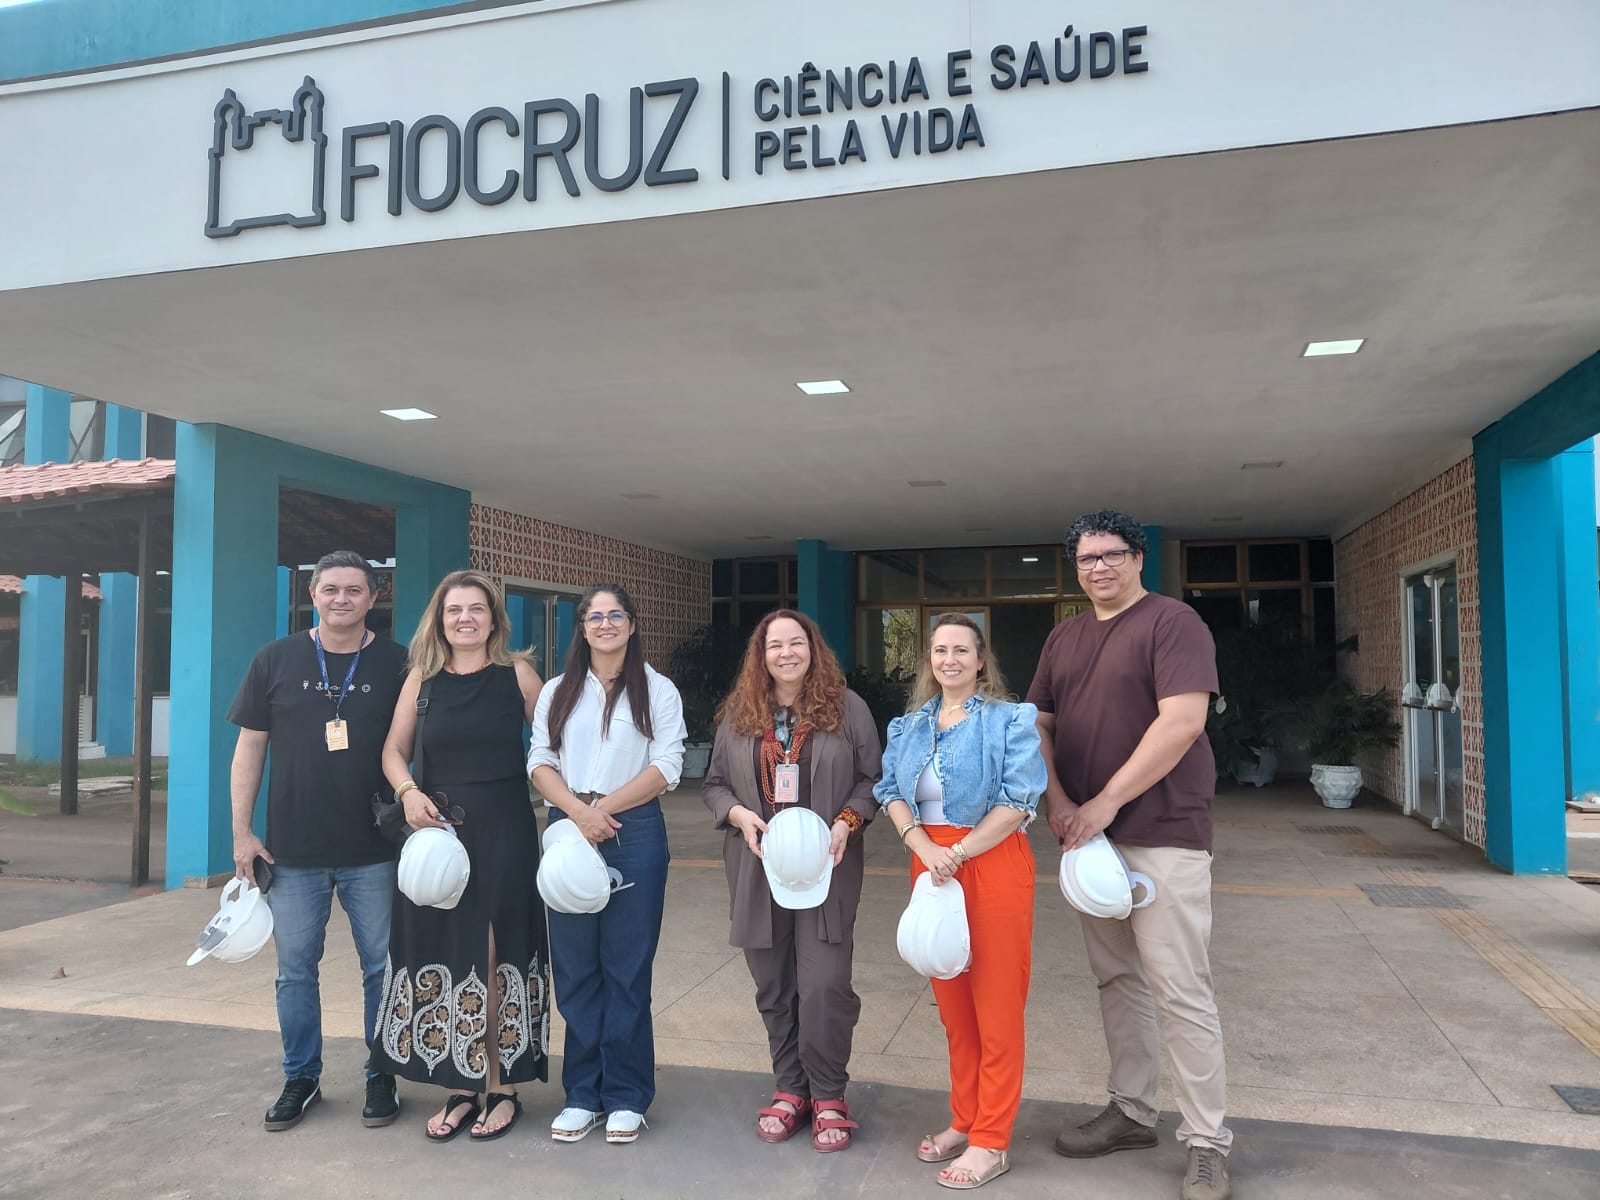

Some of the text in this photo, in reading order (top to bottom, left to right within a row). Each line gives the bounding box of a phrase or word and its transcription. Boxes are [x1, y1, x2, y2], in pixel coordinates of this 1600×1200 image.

[754, 24, 1149, 123] CIÊNCIA E SAÚDE
[340, 77, 700, 223] FIOCRUZ
[754, 103, 986, 176] PELA VIDA
